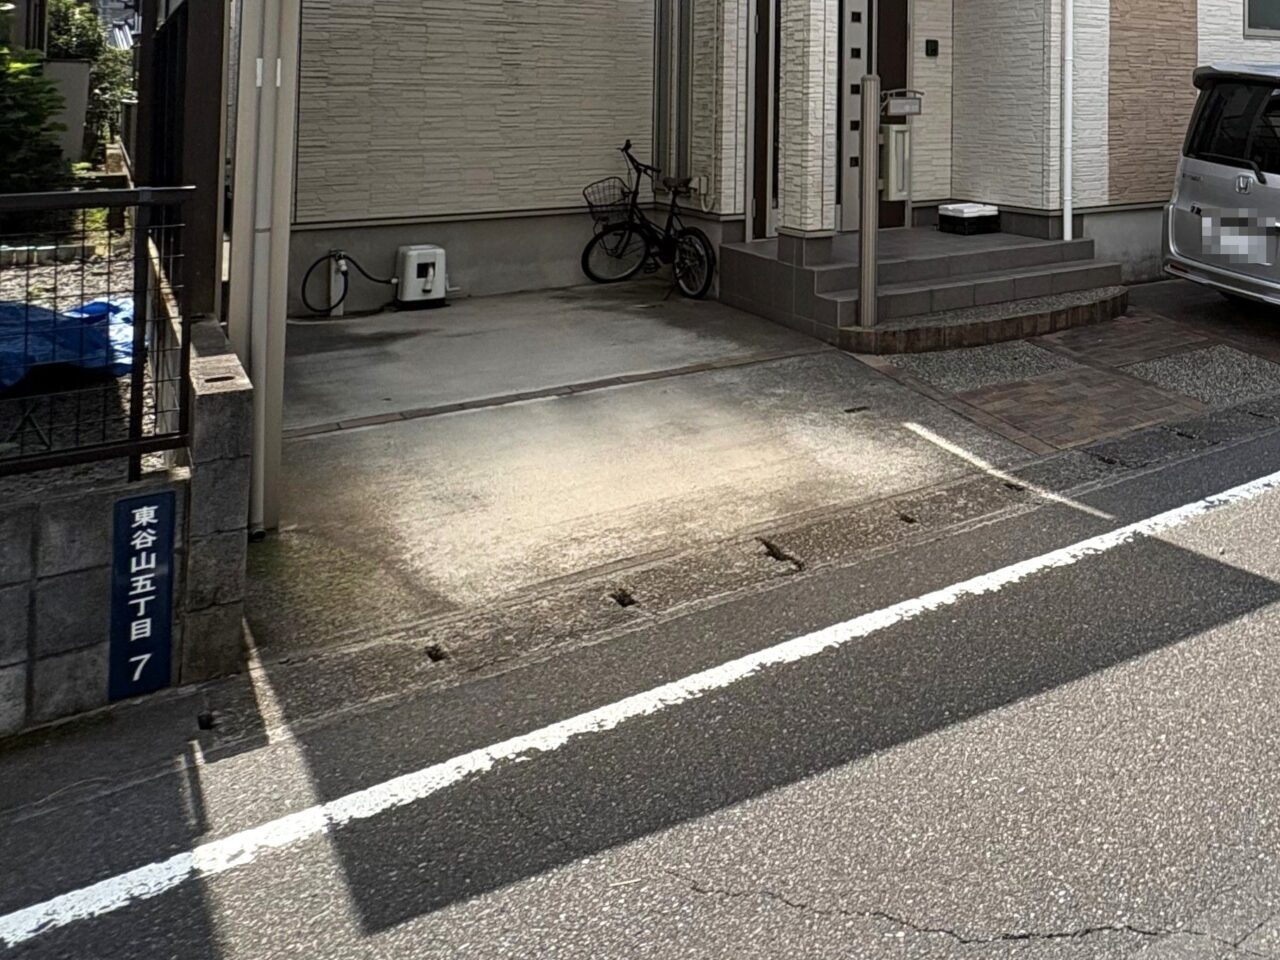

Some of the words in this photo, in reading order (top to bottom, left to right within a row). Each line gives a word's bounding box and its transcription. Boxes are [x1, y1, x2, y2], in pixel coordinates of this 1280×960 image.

[127, 504, 160, 642] 東谷山五丁目
[128, 652, 153, 682] 7
